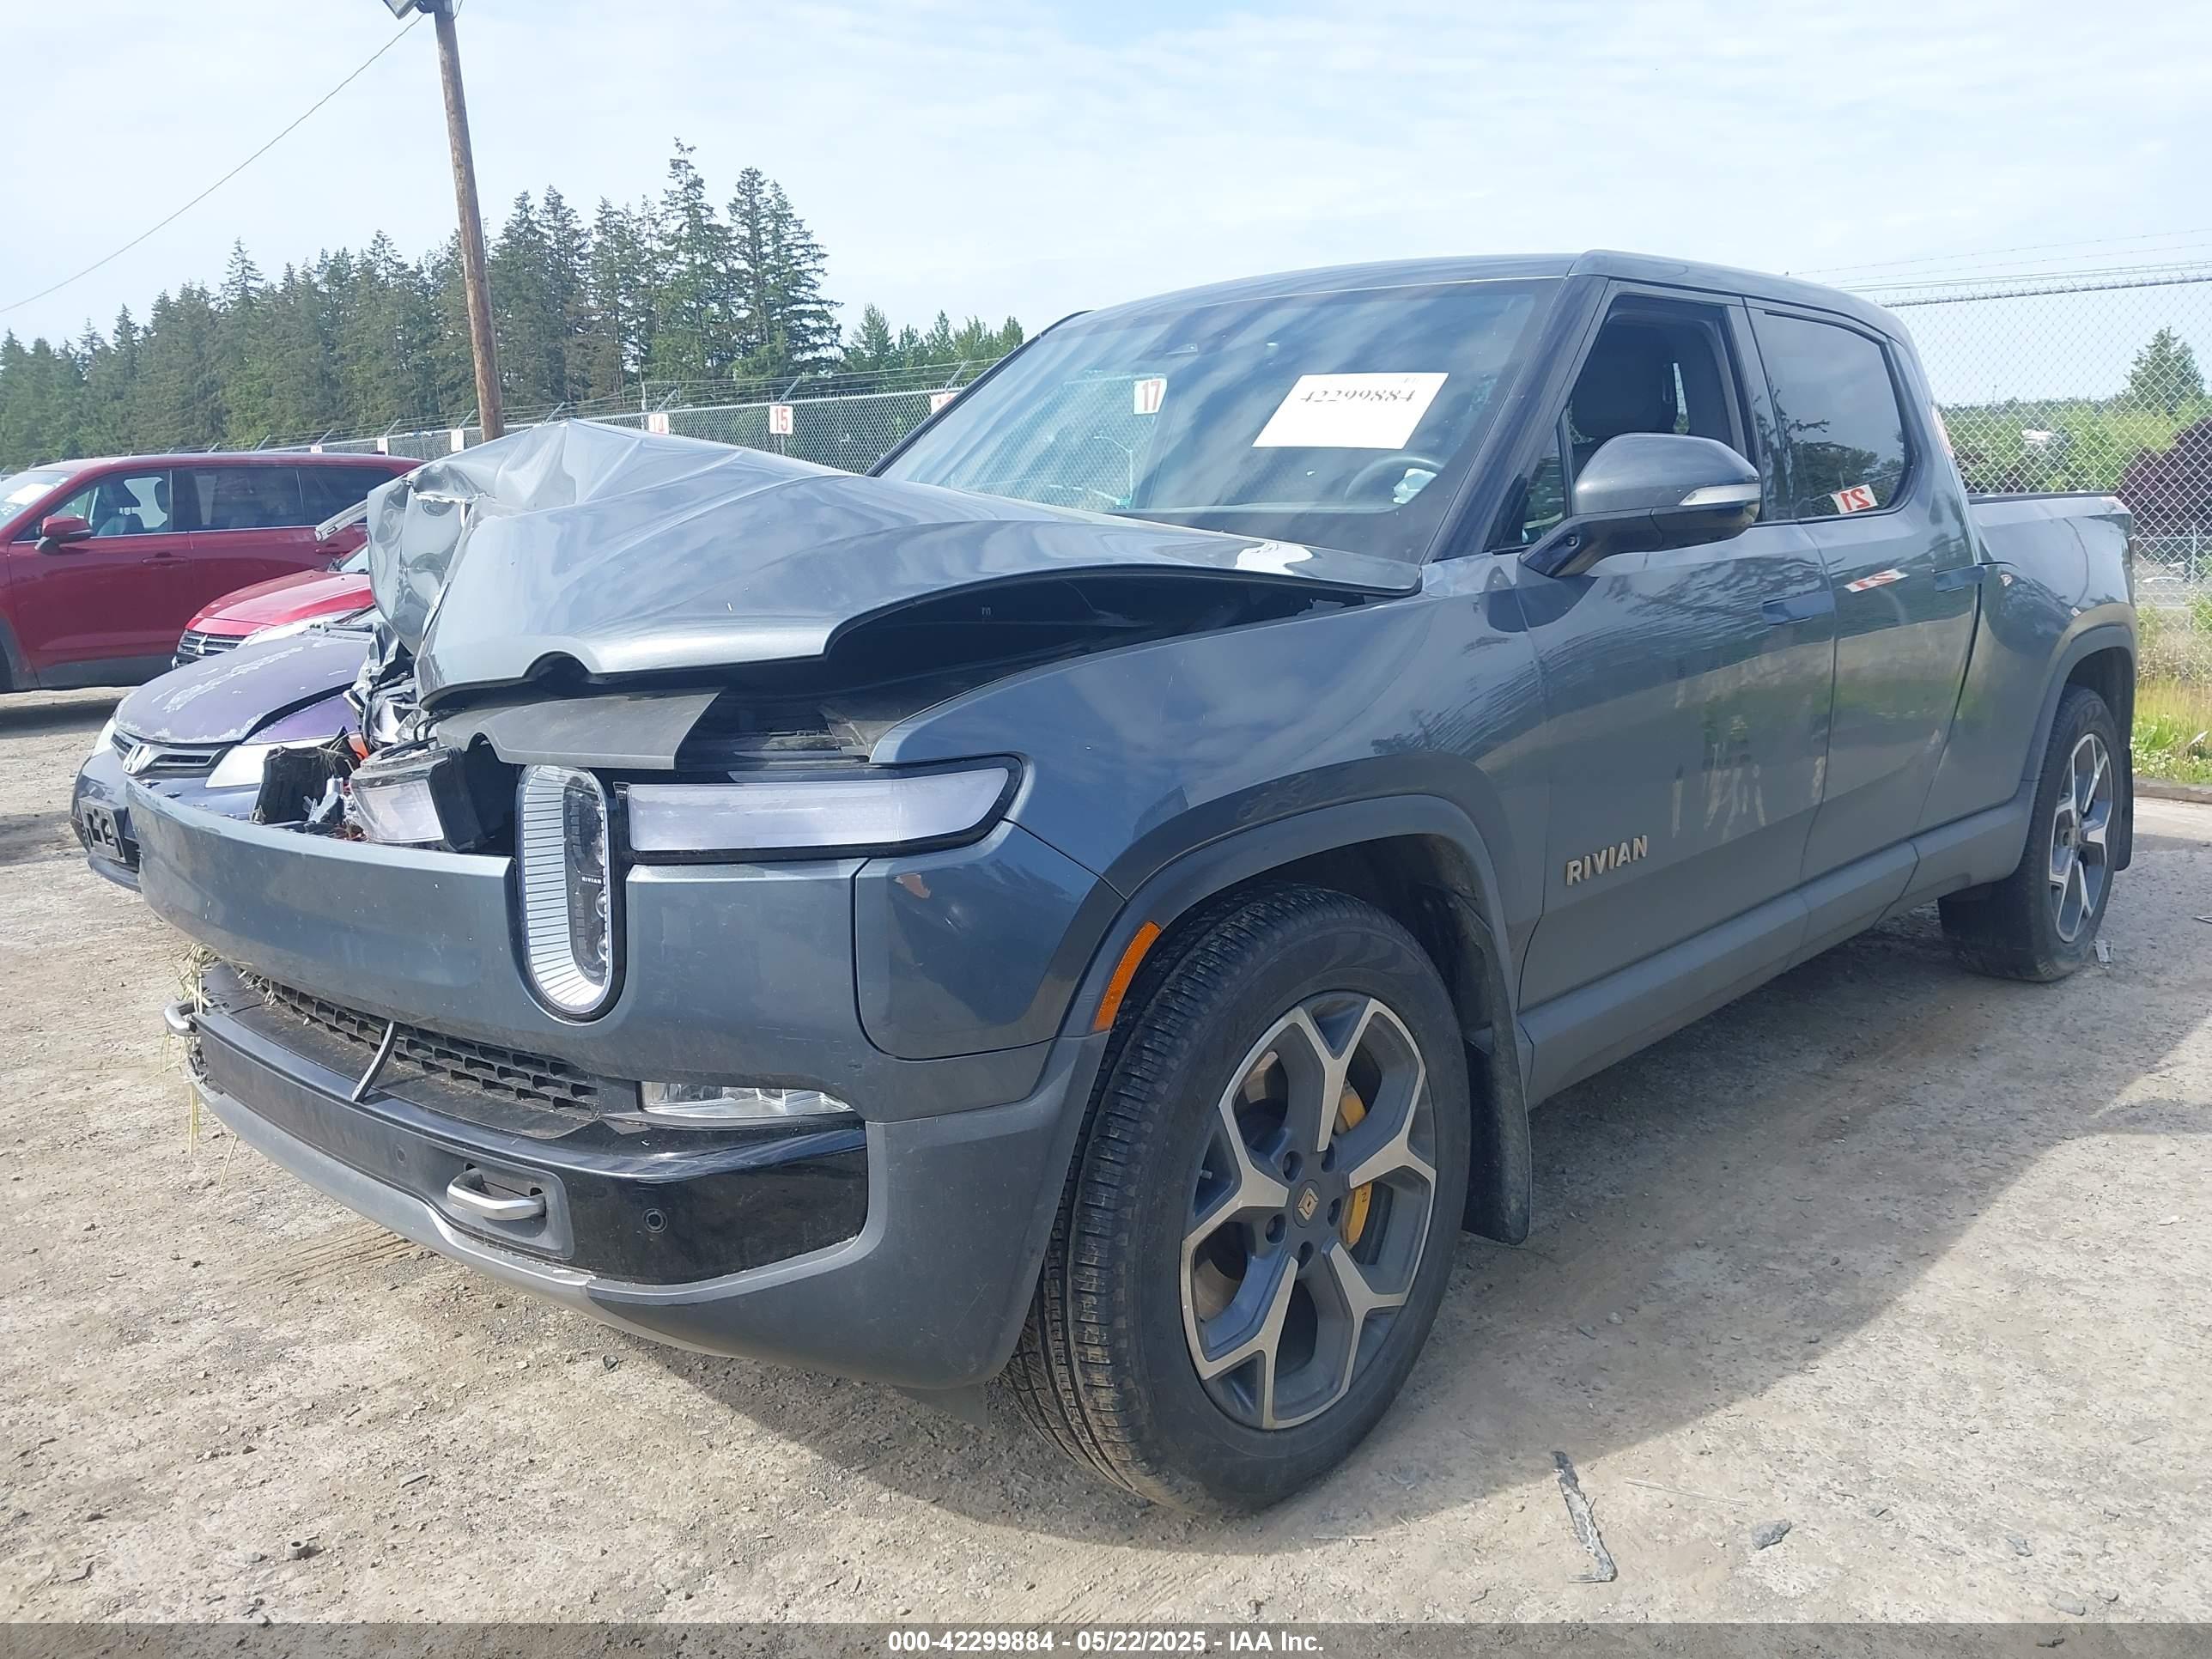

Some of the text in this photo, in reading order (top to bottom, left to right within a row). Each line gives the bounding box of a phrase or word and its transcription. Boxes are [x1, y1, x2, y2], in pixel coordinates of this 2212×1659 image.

[1142, 380, 1161, 411] 17
[1299, 389, 1416, 403] 42299884
[775, 407, 789, 432] 15
[1566, 835, 1648, 885] RIVIAN
